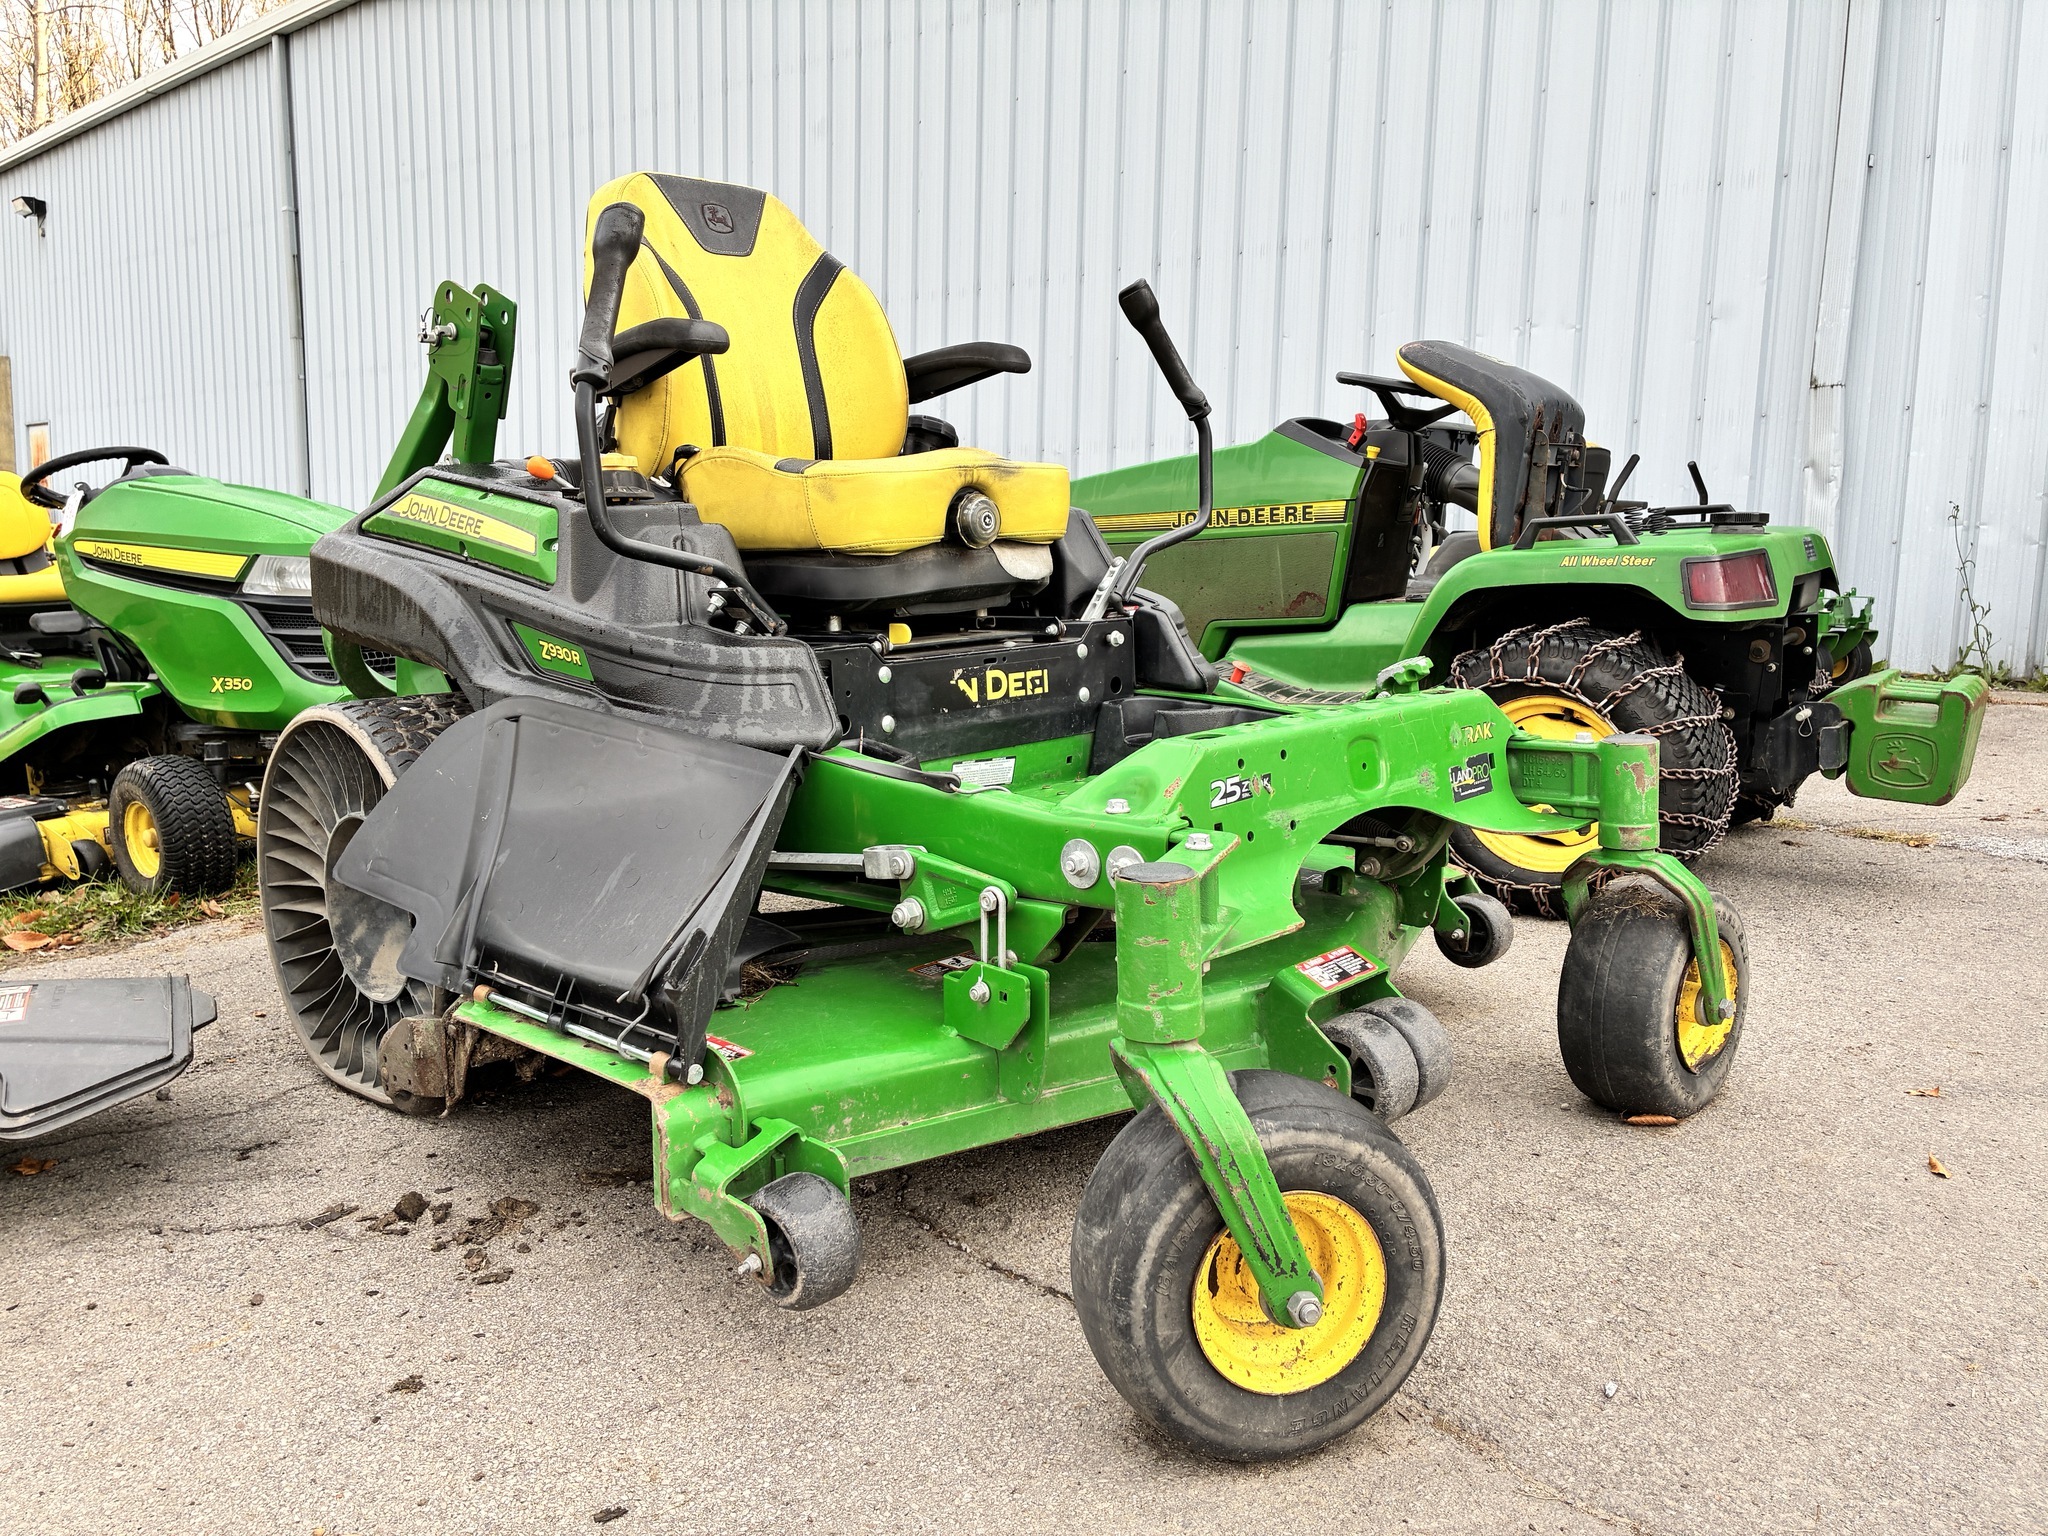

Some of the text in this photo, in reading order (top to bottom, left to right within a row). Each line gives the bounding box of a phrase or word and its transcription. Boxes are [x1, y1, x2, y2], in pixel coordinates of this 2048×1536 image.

[402, 497, 484, 535] JOHN DEERE
[1172, 504, 1314, 528] JON DEERE
[92, 543, 143, 565] JOHN DEERE
[1560, 554, 1656, 567] All Wheel Steer
[538, 639, 583, 667] Z930R
[210, 675, 253, 694] X350
